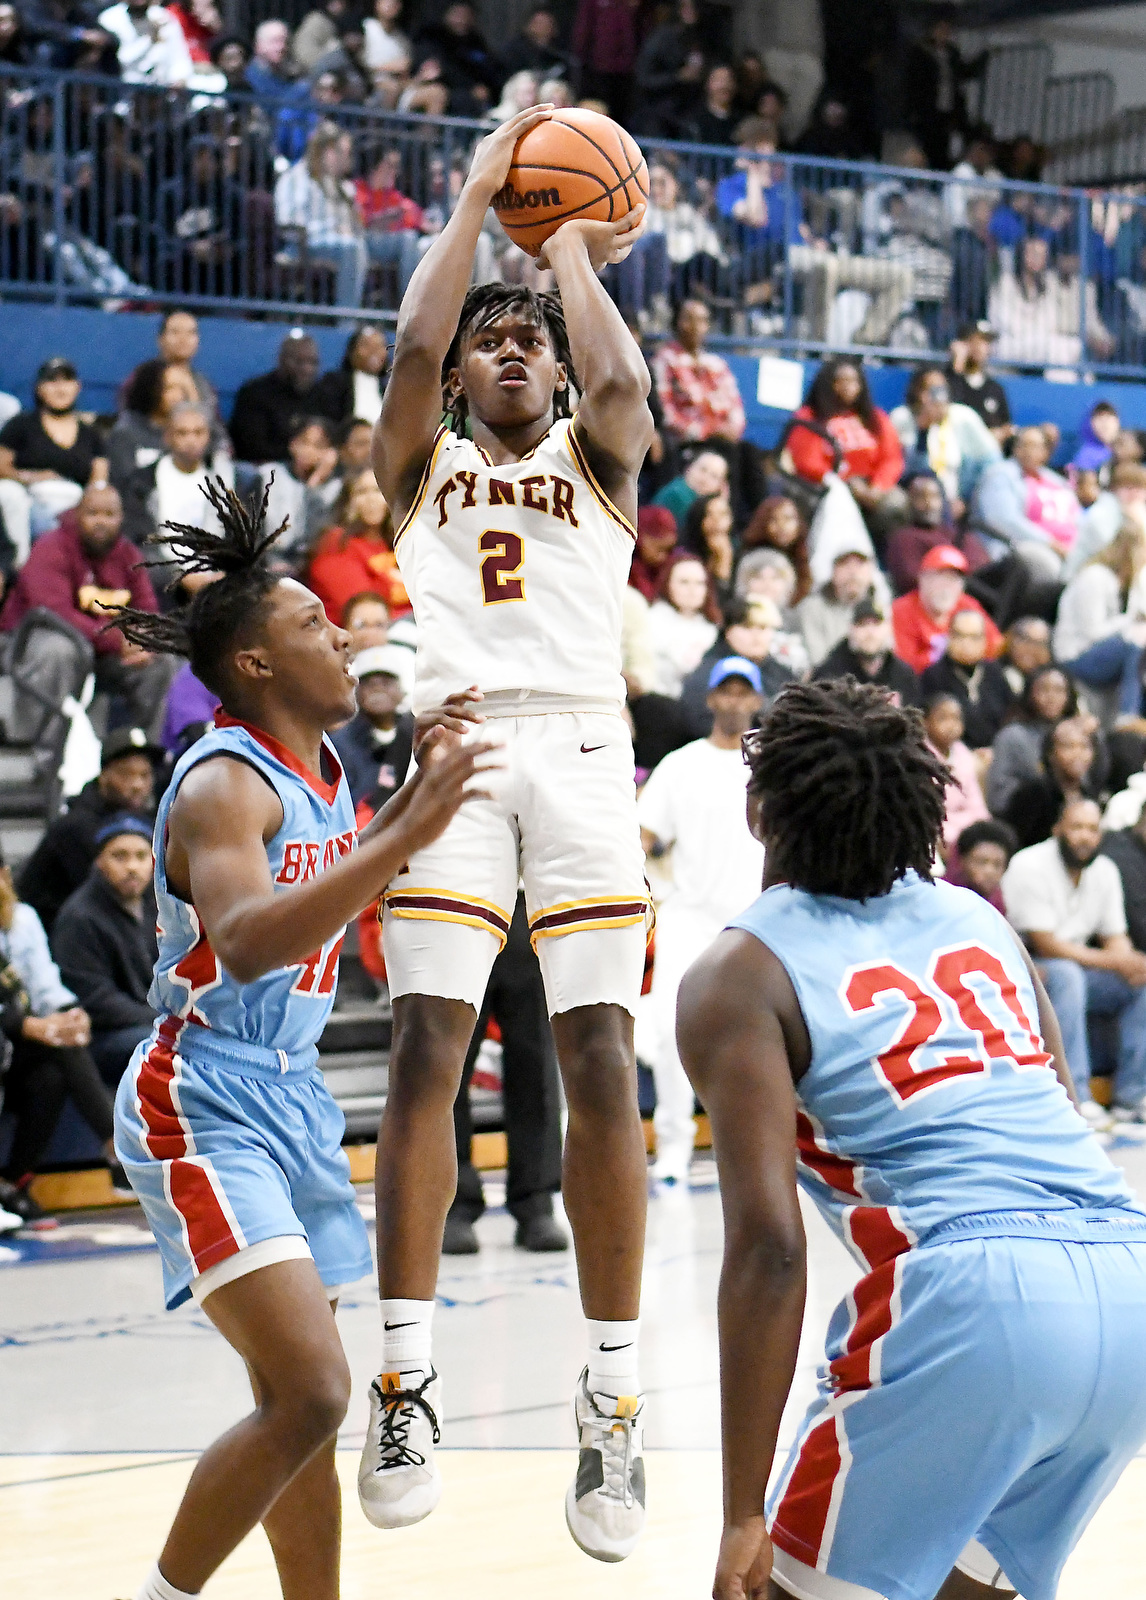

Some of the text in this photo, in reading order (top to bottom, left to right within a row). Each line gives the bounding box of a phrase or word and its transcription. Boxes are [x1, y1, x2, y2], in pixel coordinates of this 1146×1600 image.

[489, 182, 562, 210] ilson
[433, 470, 579, 529] TYNER
[478, 528, 526, 607] 2
[838, 939, 1054, 1111] 20
